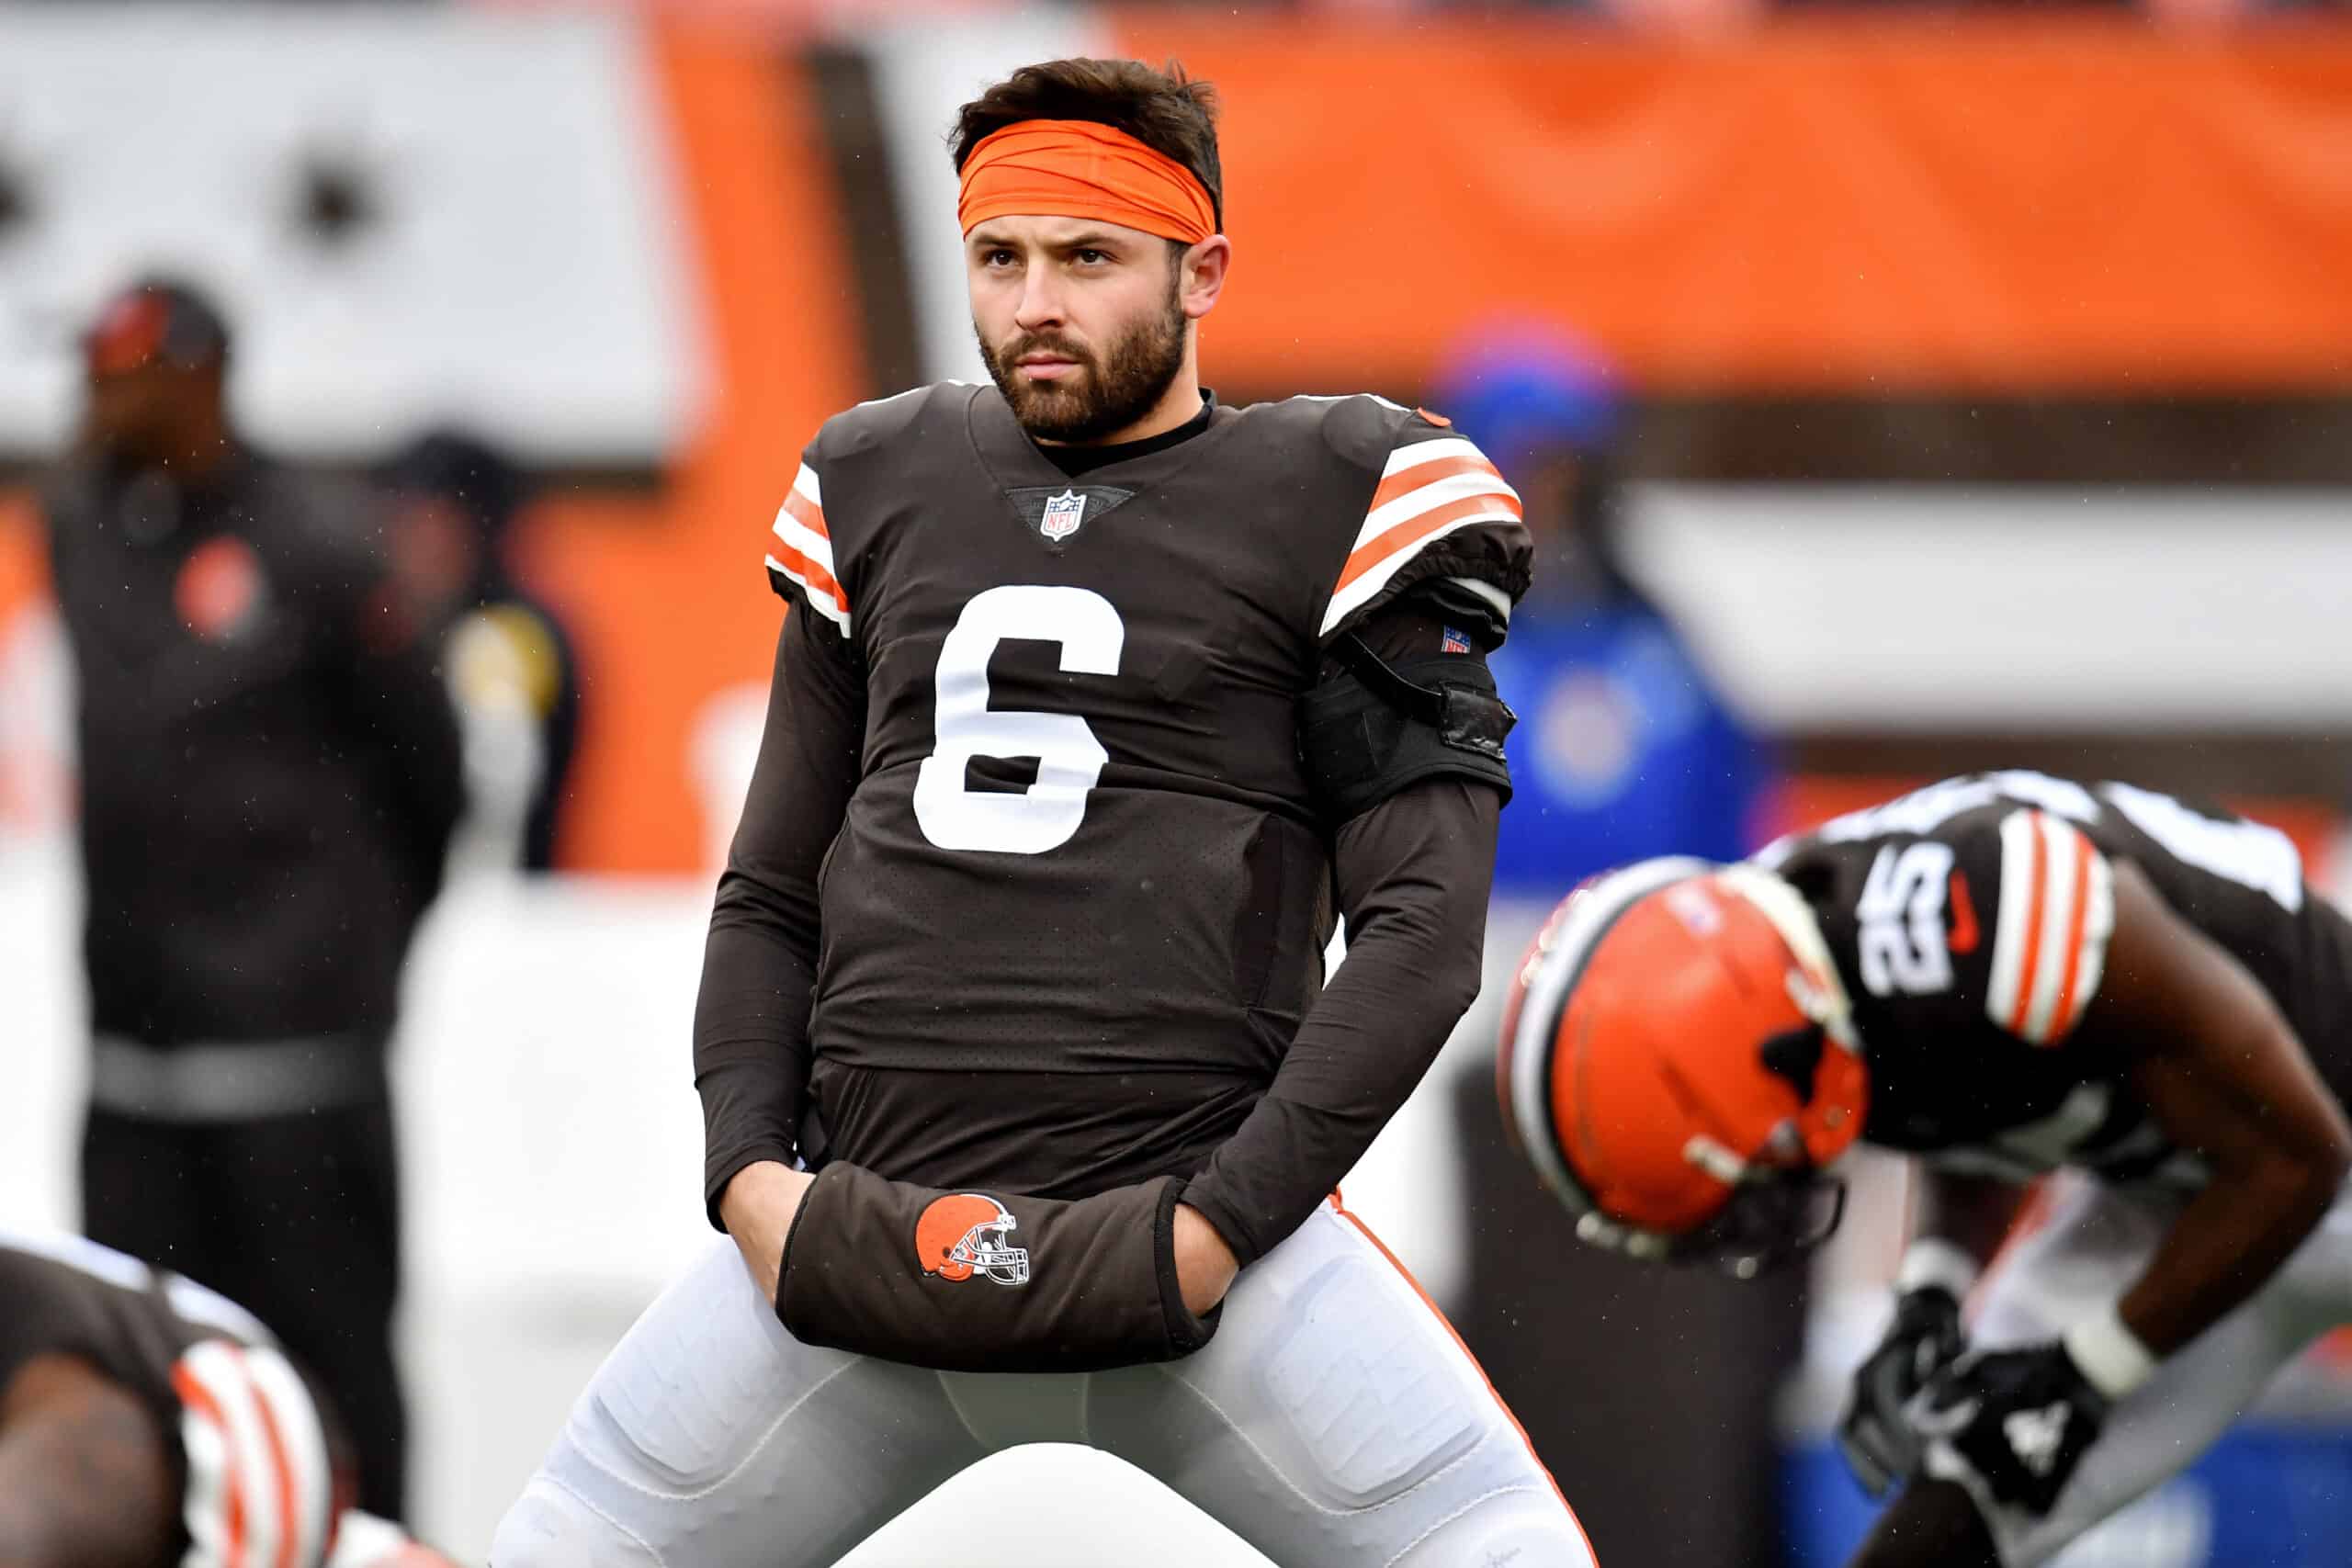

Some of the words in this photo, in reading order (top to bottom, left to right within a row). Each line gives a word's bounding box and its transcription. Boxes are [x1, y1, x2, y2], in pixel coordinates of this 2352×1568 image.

[1046, 513, 1074, 530] NFL
[912, 585, 1125, 854] 6
[1855, 842, 1954, 997] 25
